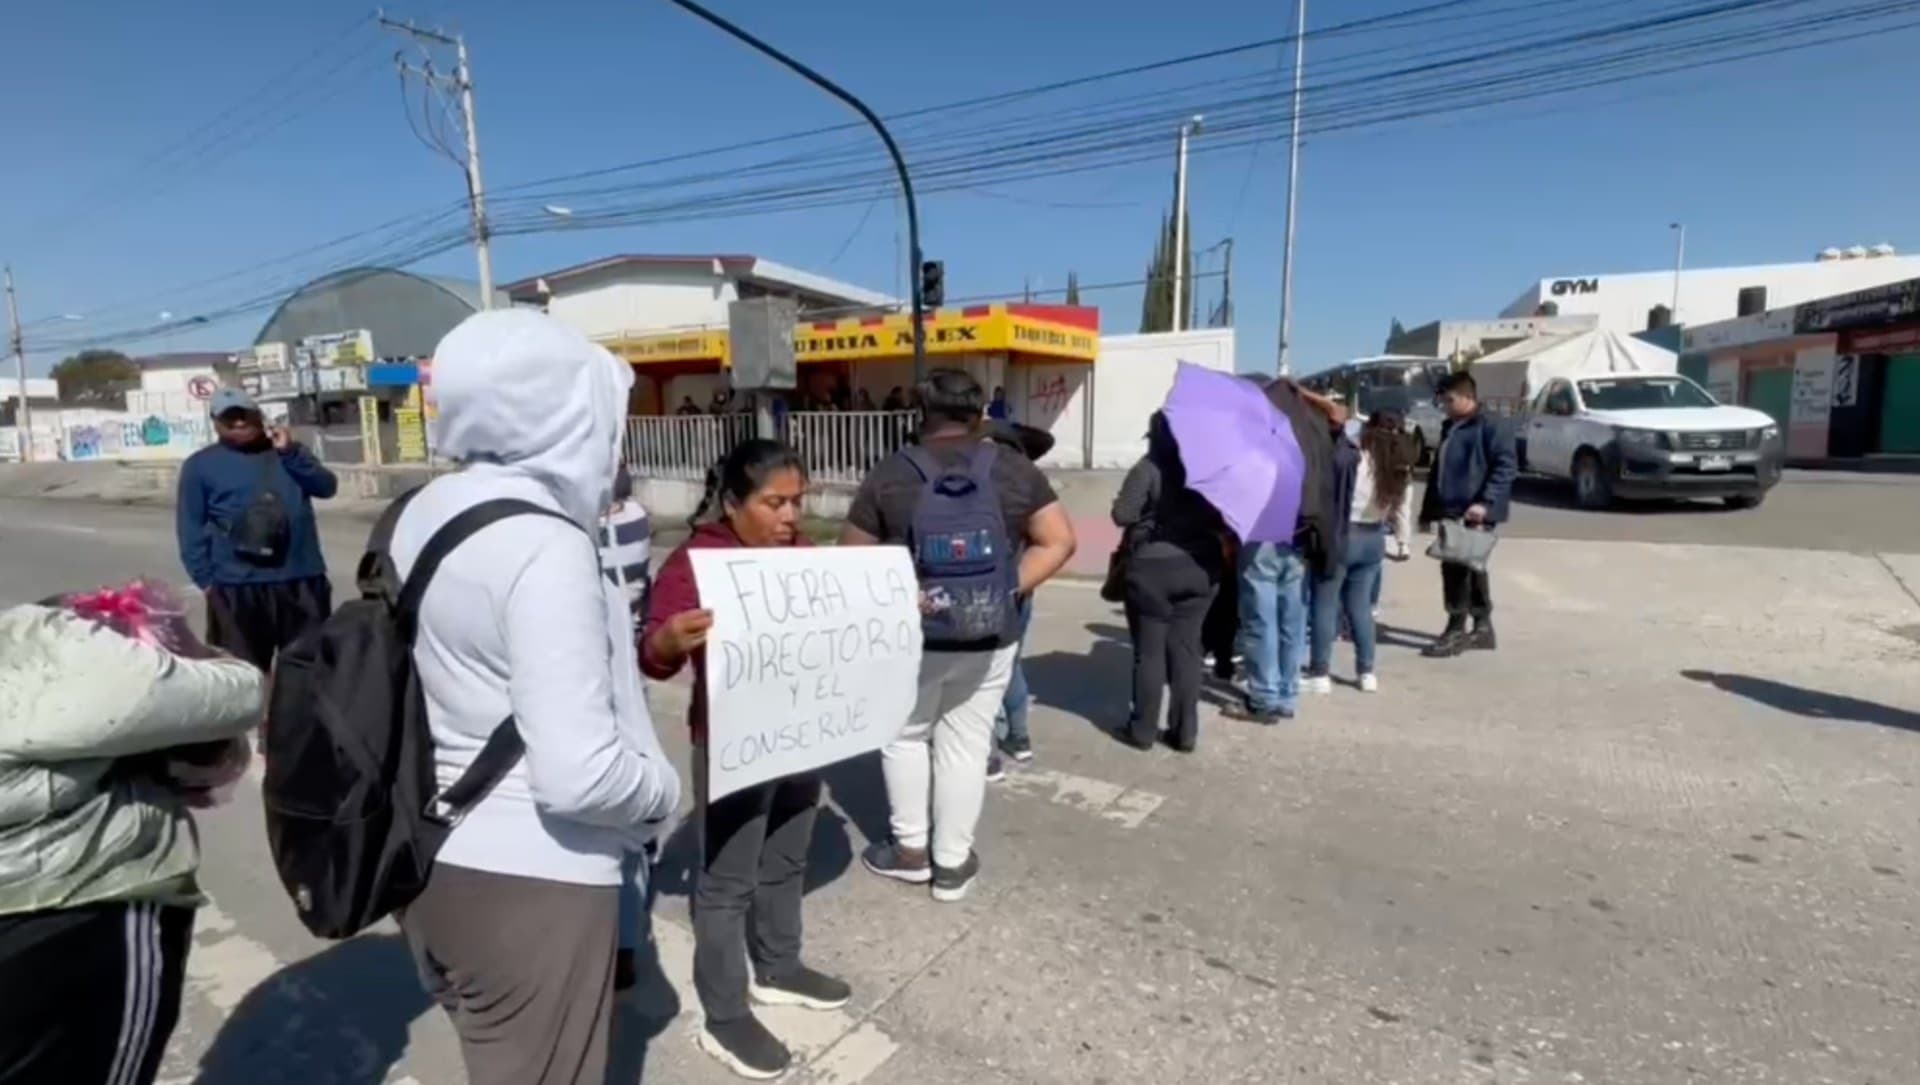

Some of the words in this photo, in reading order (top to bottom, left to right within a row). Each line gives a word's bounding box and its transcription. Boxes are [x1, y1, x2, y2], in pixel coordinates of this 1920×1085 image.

[1551, 279, 1598, 296] GYM
[794, 334, 878, 353] UERIA
[894, 326, 977, 345] AEX
[726, 559, 847, 630] FUERA
[865, 568, 908, 607] LA
[721, 617, 912, 690] DIRECTORA
[788, 682, 799, 708] Y
[815, 674, 844, 700] EL
[720, 698, 867, 772] CONSERJE
